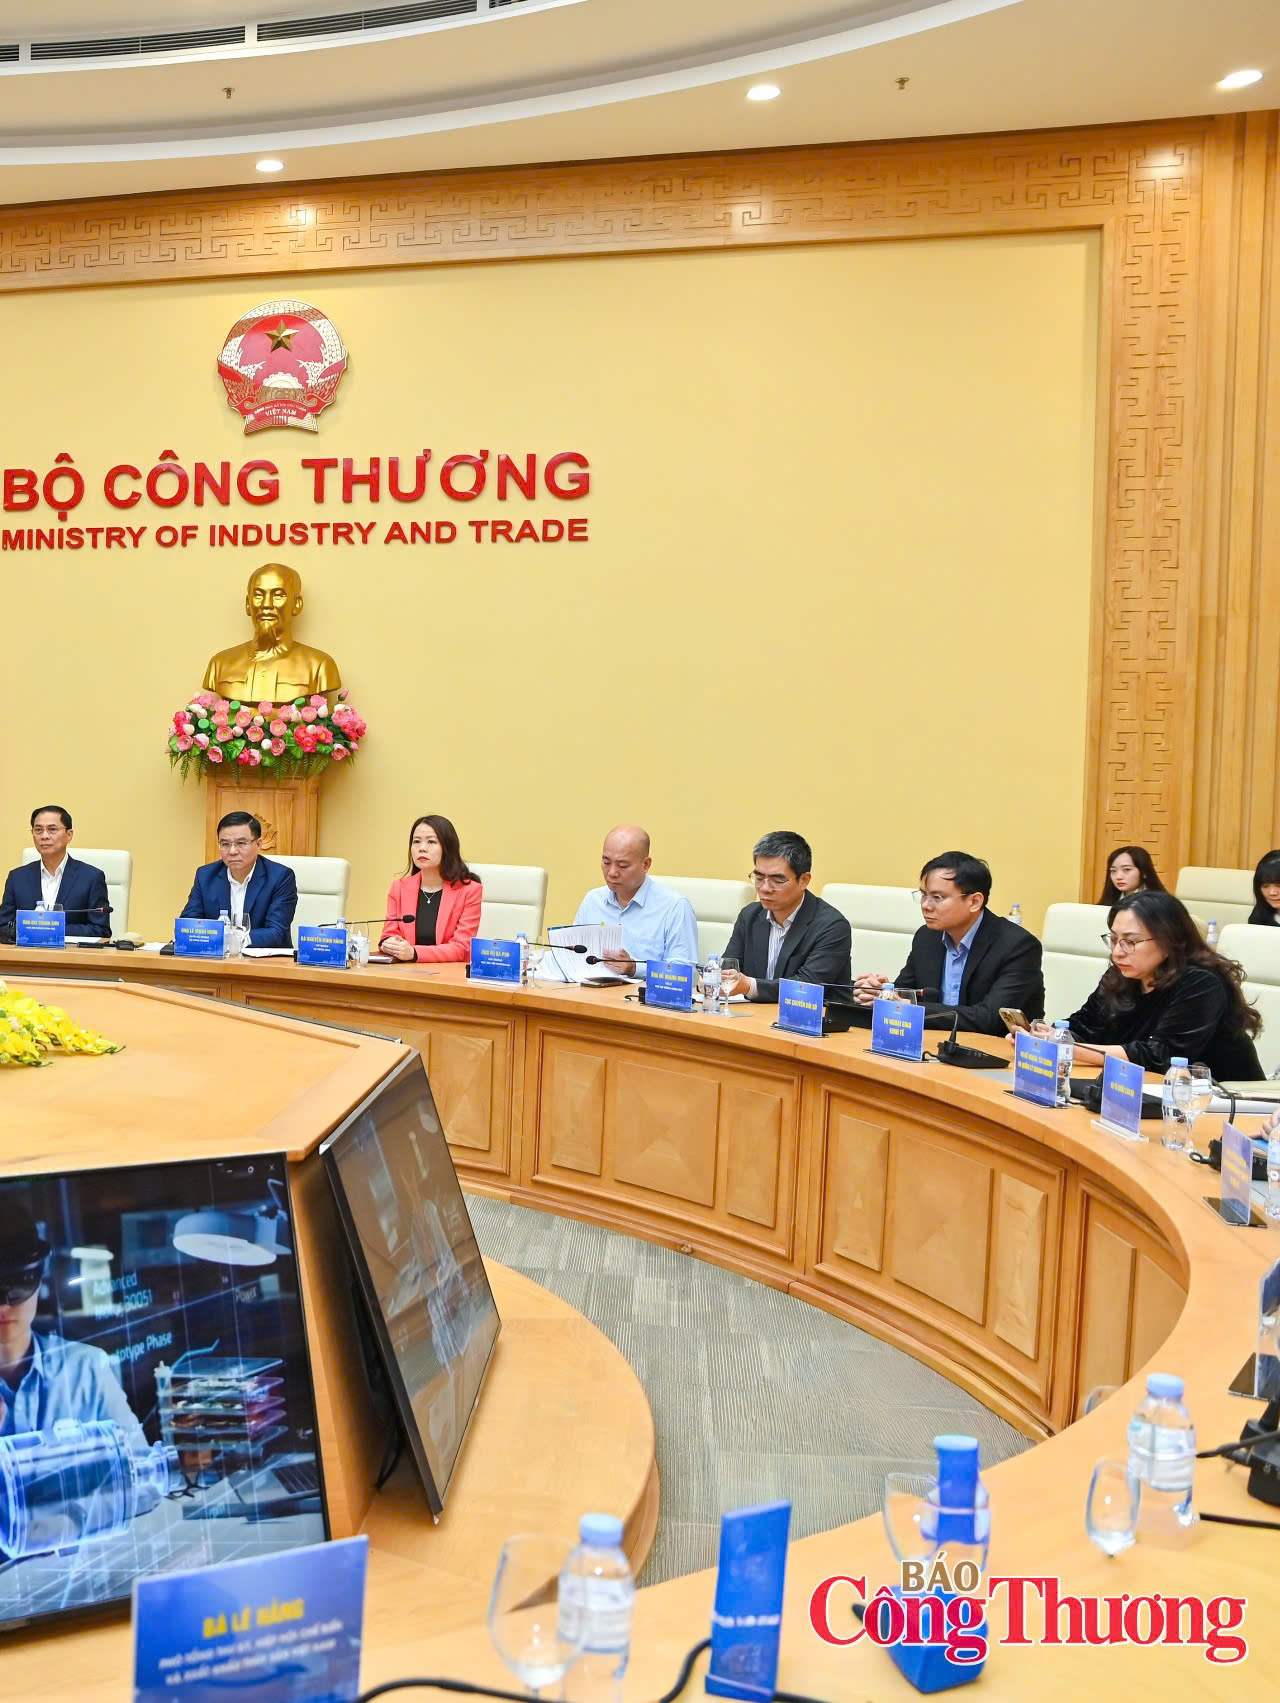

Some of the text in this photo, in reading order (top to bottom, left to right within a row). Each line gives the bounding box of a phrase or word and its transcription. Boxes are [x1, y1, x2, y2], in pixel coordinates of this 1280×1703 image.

[282, 408, 296, 416] NAM
[3, 449, 590, 521] BỘ CÔNG THƯƠNG
[2, 518, 589, 550] MINISTRY OF INDUSTRY AND TRADE
[792, 1000, 805, 1008] CHUYỂN
[236, 1286, 257, 1302] Power
[146, 1332, 173, 1351] Phase
[204, 1616, 227, 1639] BÀ
[232, 1606, 250, 1632] LÊ
